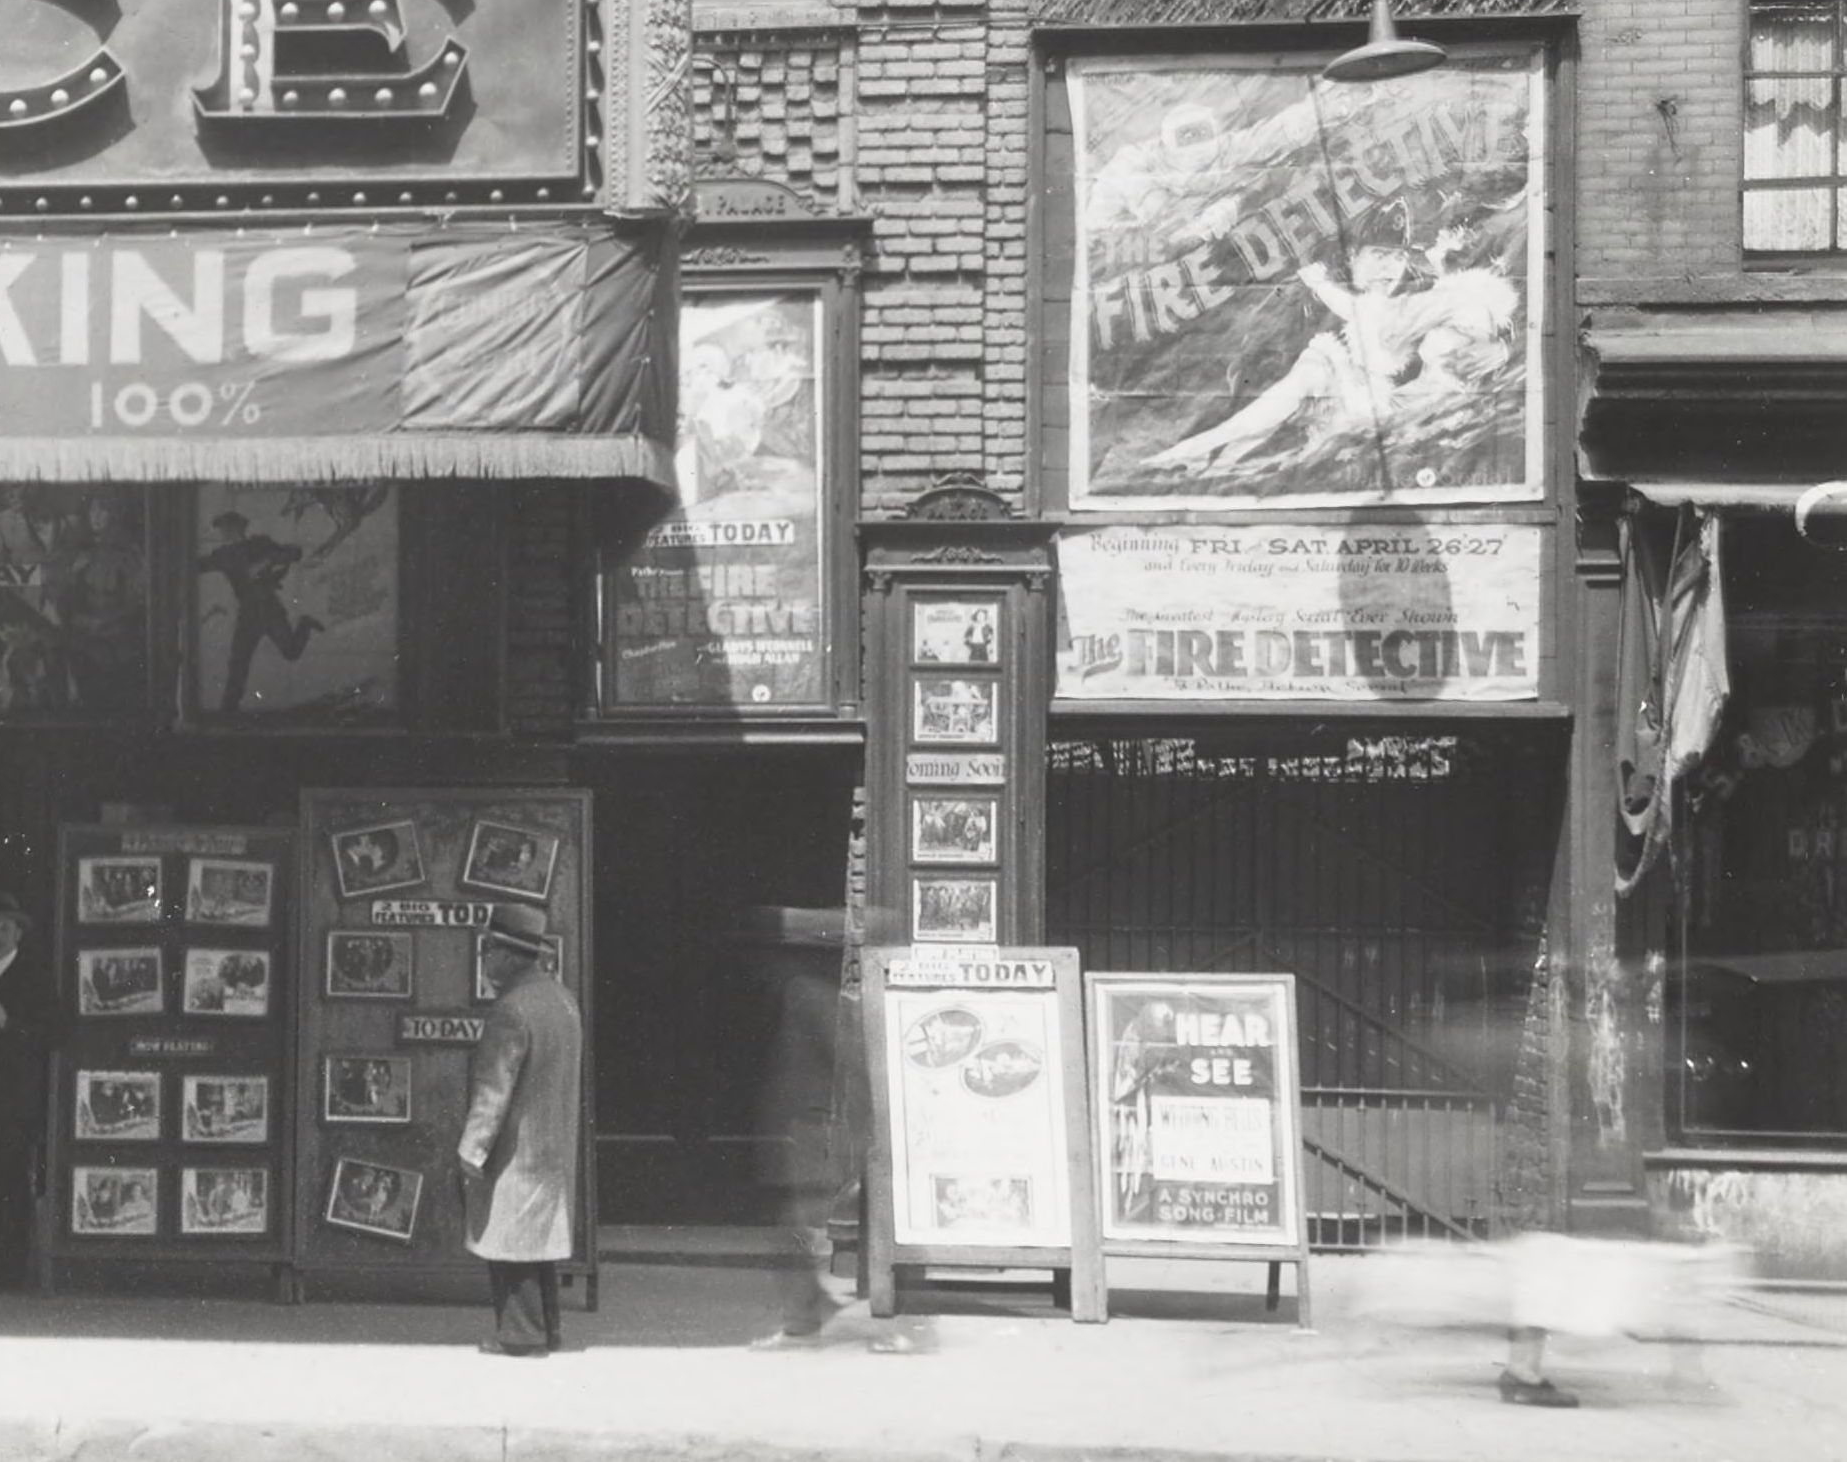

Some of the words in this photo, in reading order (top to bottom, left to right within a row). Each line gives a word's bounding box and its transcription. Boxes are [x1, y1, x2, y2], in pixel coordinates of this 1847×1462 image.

[716, 195, 786, 216] PALACE
[1093, 247, 1234, 350] FIRE
[1230, 99, 1527, 282] DETECTIVE
[91, 382, 261, 428] 100%
[709, 523, 791, 541] TODAY
[1338, 538, 1420, 556] APRIL
[1224, 559, 1275, 577] Friday
[1303, 558, 1372, 577] Saturday
[688, 565, 778, 598] FIRE
[616, 599, 815, 636] DETECTIVE
[1396, 608, 1460, 625] Shown
[1067, 632, 1124, 684] The
[1127, 629, 1249, 677] FIRE
[1254, 629, 1528, 677] DETECTIVE
[374, 912, 436, 925] FEATURES
[438, 904, 490, 925] TOD
[958, 963, 1047, 982] TODAY
[1175, 1010, 1273, 1048] HEAR
[1190, 1058, 1253, 1086] SEE
[1160, 1155, 1195, 1171] GENE
[1210, 1156, 1264, 1172] AUSTIN
[1159, 1191, 1173, 1205] A
[1178, 1191, 1270, 1207] SYNCHRO
